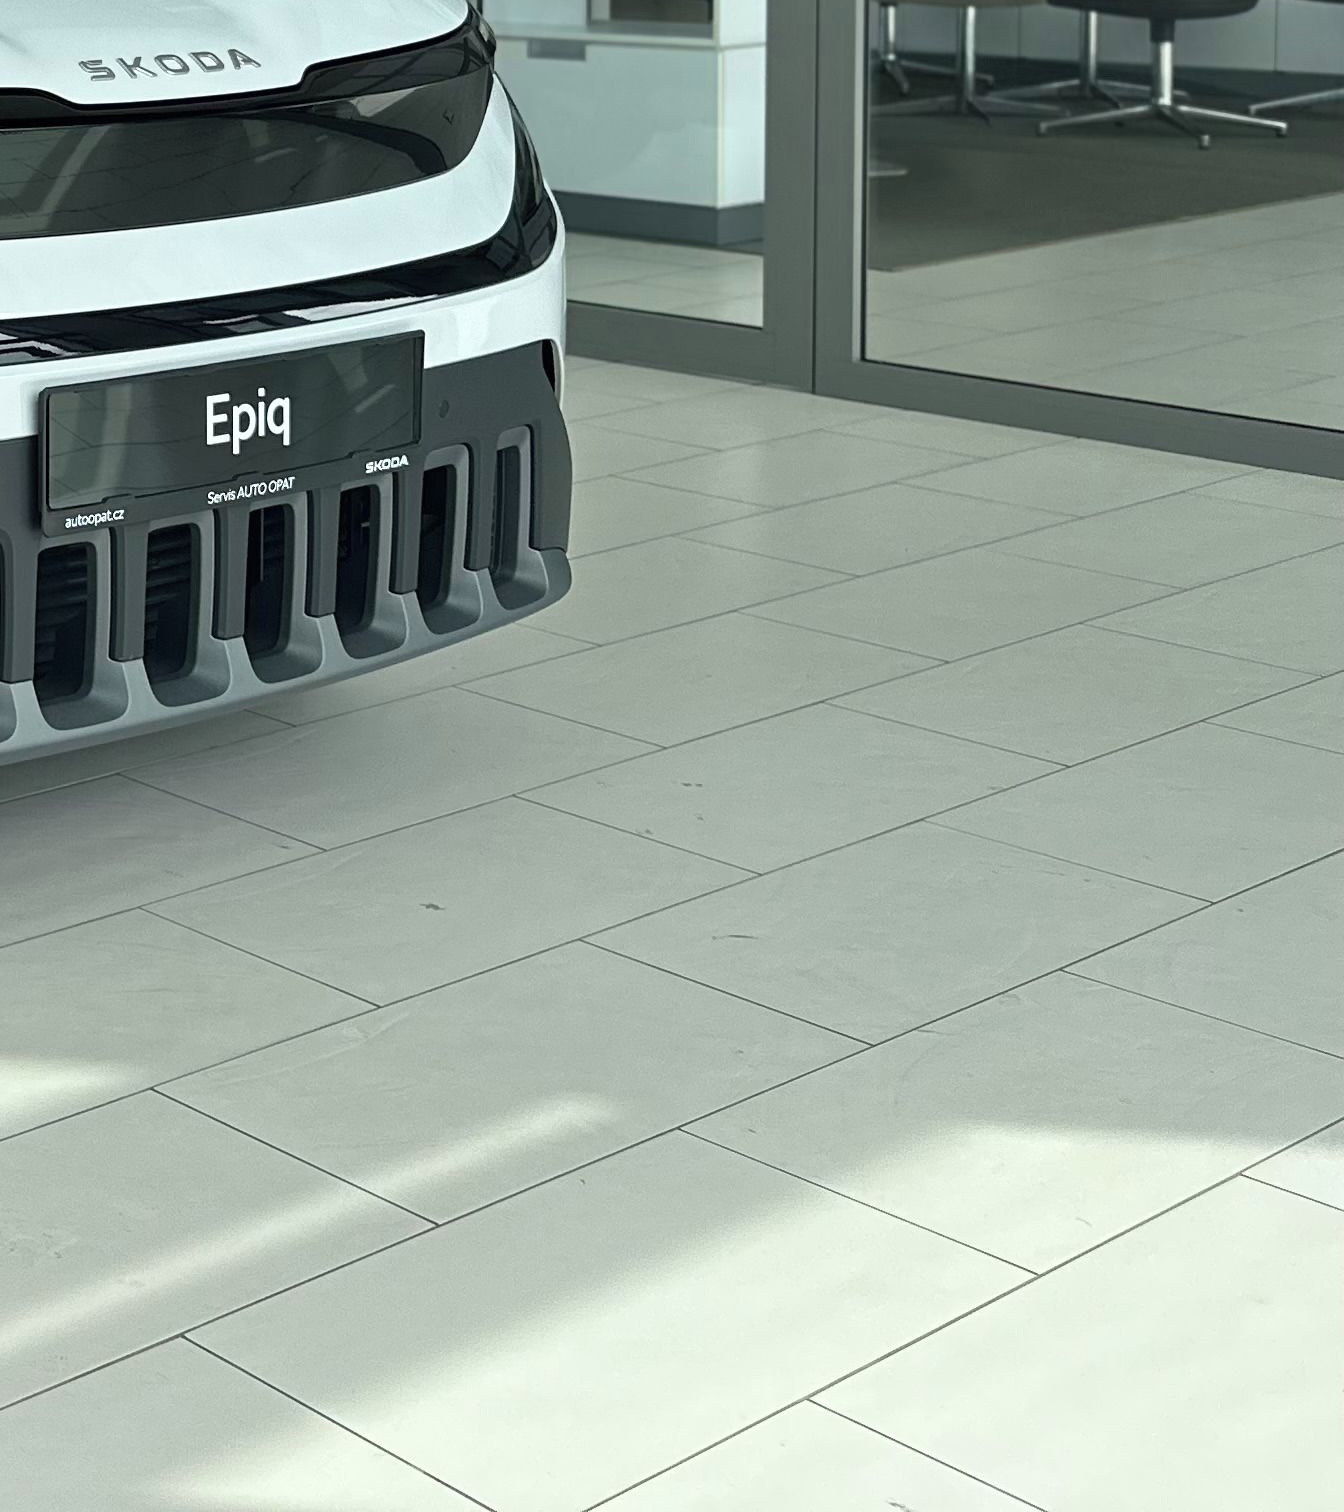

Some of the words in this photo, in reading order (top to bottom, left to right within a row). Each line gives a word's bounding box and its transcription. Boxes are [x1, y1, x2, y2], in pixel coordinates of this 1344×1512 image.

[206, 387, 291, 455] Epiq
[207, 488, 237, 505] Servis
[237, 481, 267, 500] AUTO
[268, 476, 296, 493] OPAT
[64, 508, 125, 529] autoopat.cz
